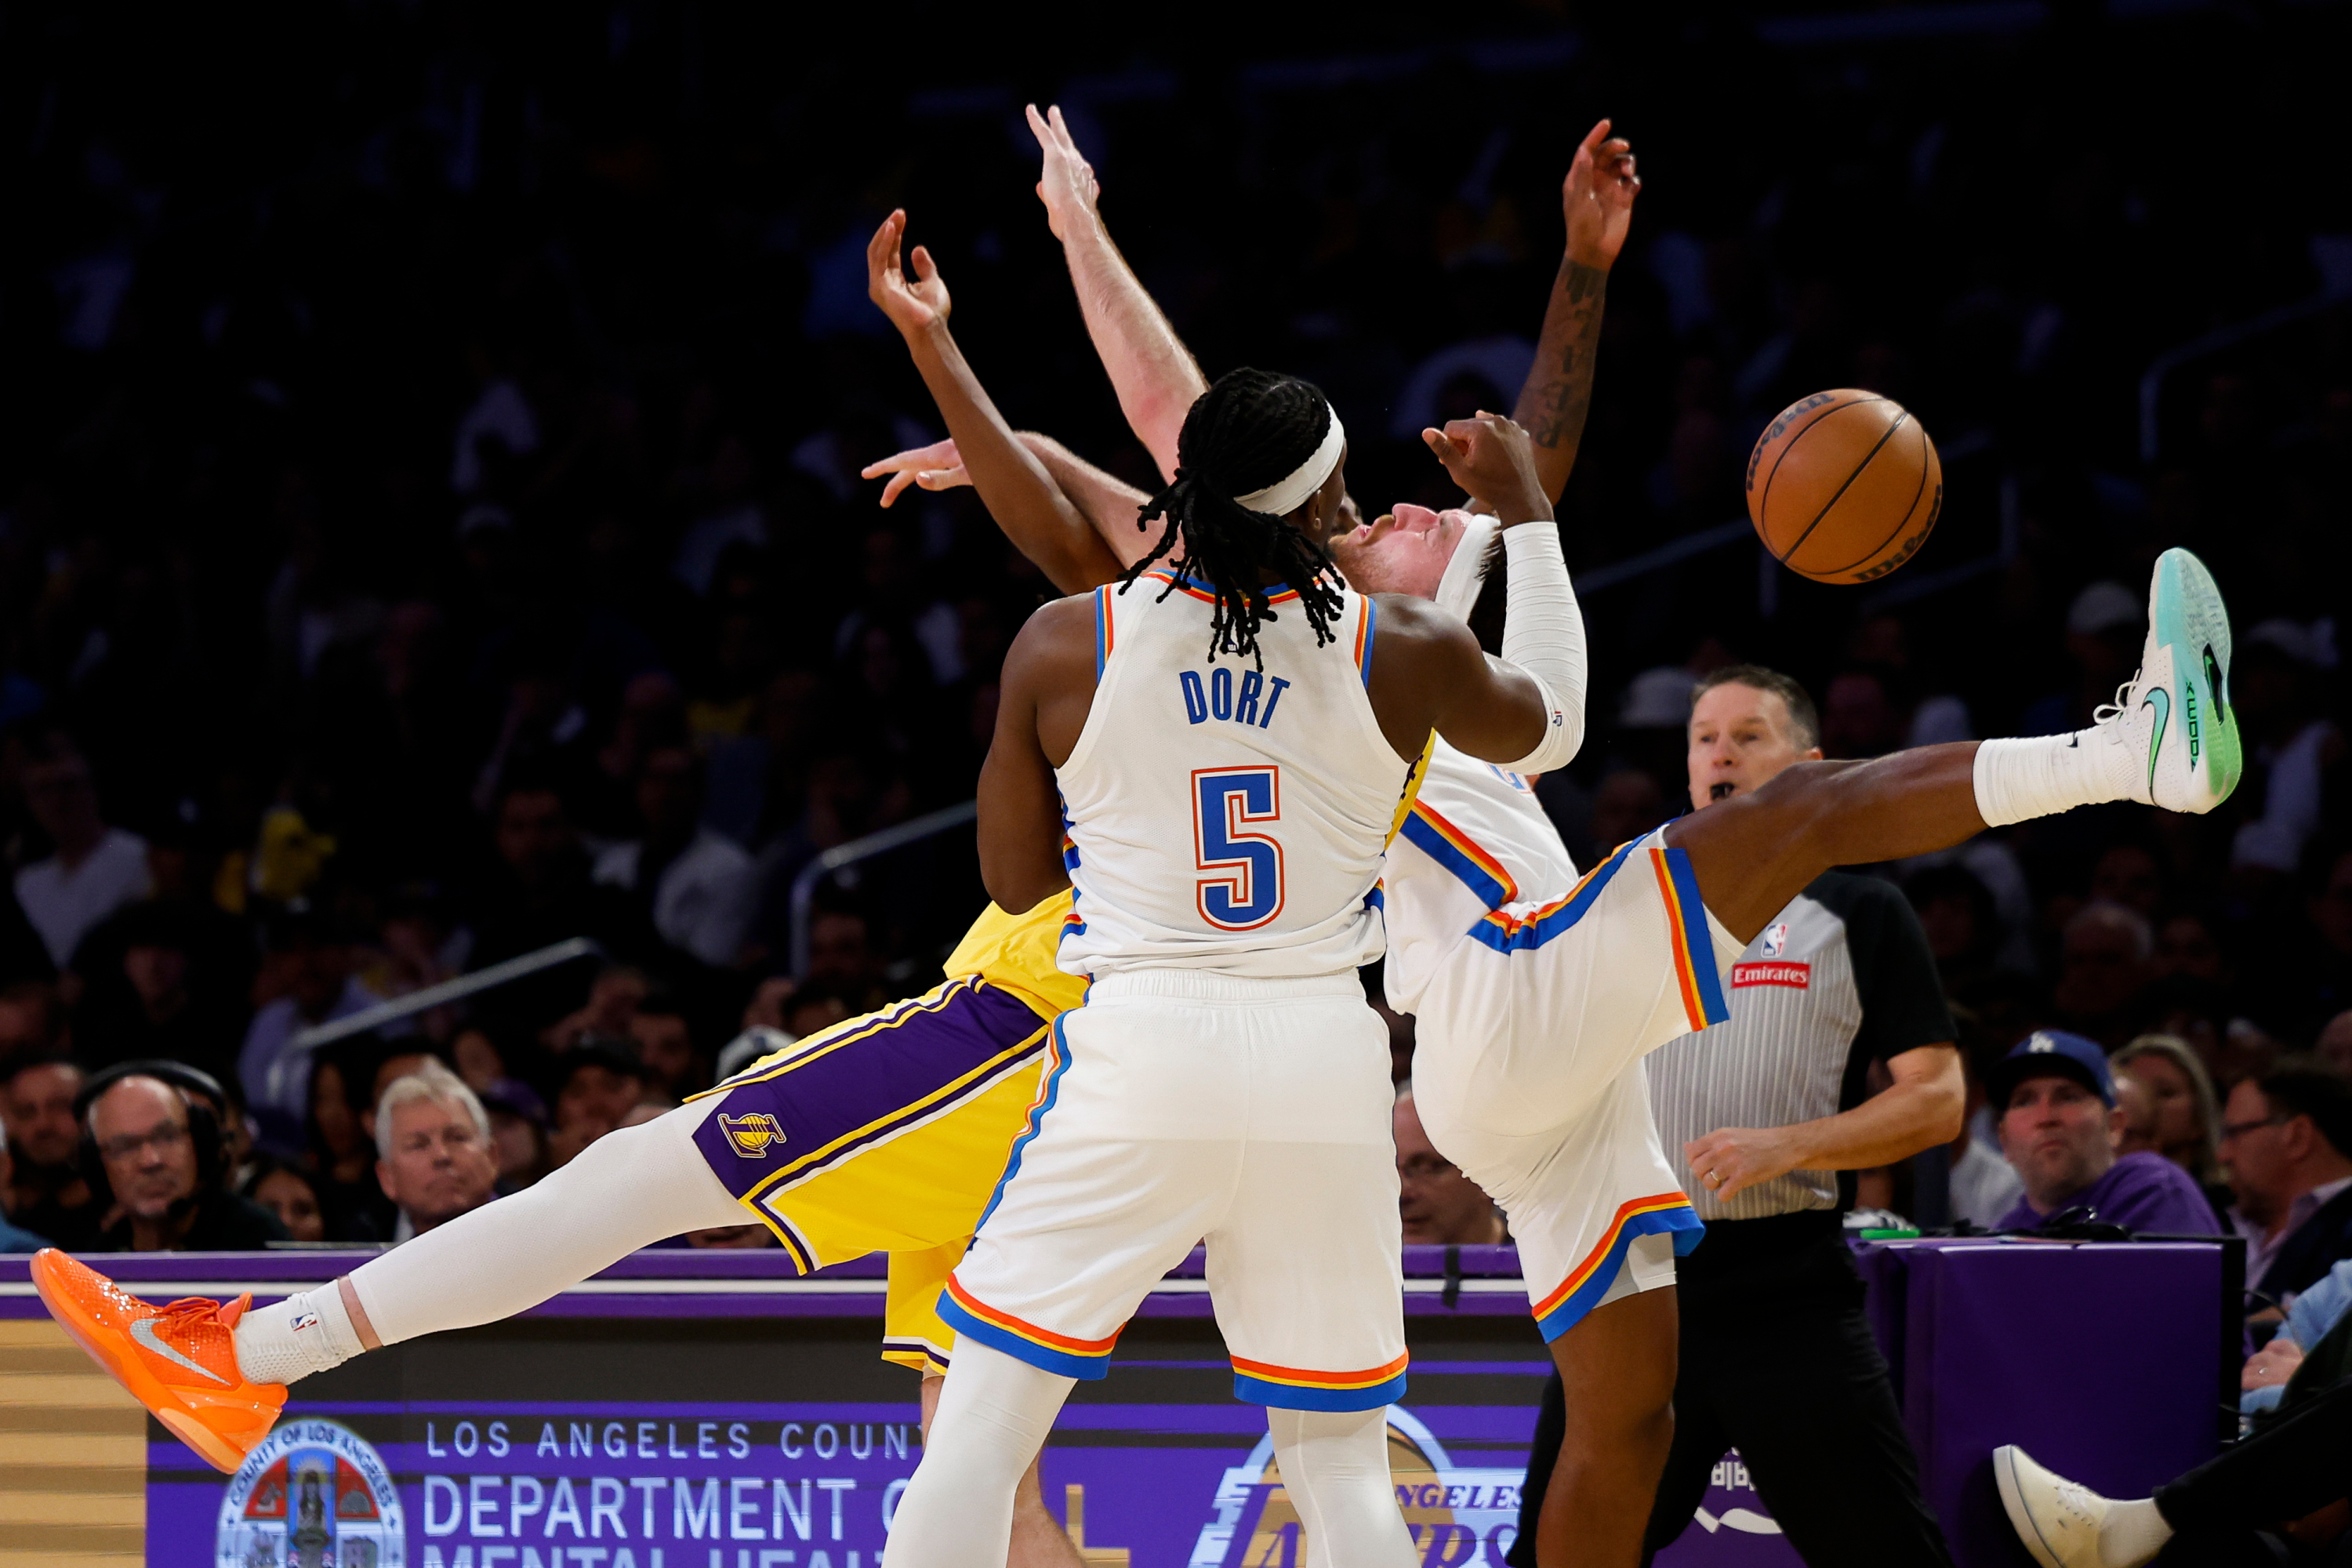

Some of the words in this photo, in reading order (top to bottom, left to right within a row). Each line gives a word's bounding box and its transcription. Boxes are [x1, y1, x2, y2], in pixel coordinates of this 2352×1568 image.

[1179, 667, 1290, 729] DORT
[1191, 764, 1285, 931] 5
[1734, 965, 1807, 983] Emirates
[308, 1424, 335, 1443] LOS
[426, 1421, 510, 1458] LOS
[536, 1422, 750, 1460] ANGELES
[780, 1423, 922, 1460] COUN
[424, 1475, 857, 1541] DEPARTMENT
[1395, 1483, 1521, 1509] NGELE
